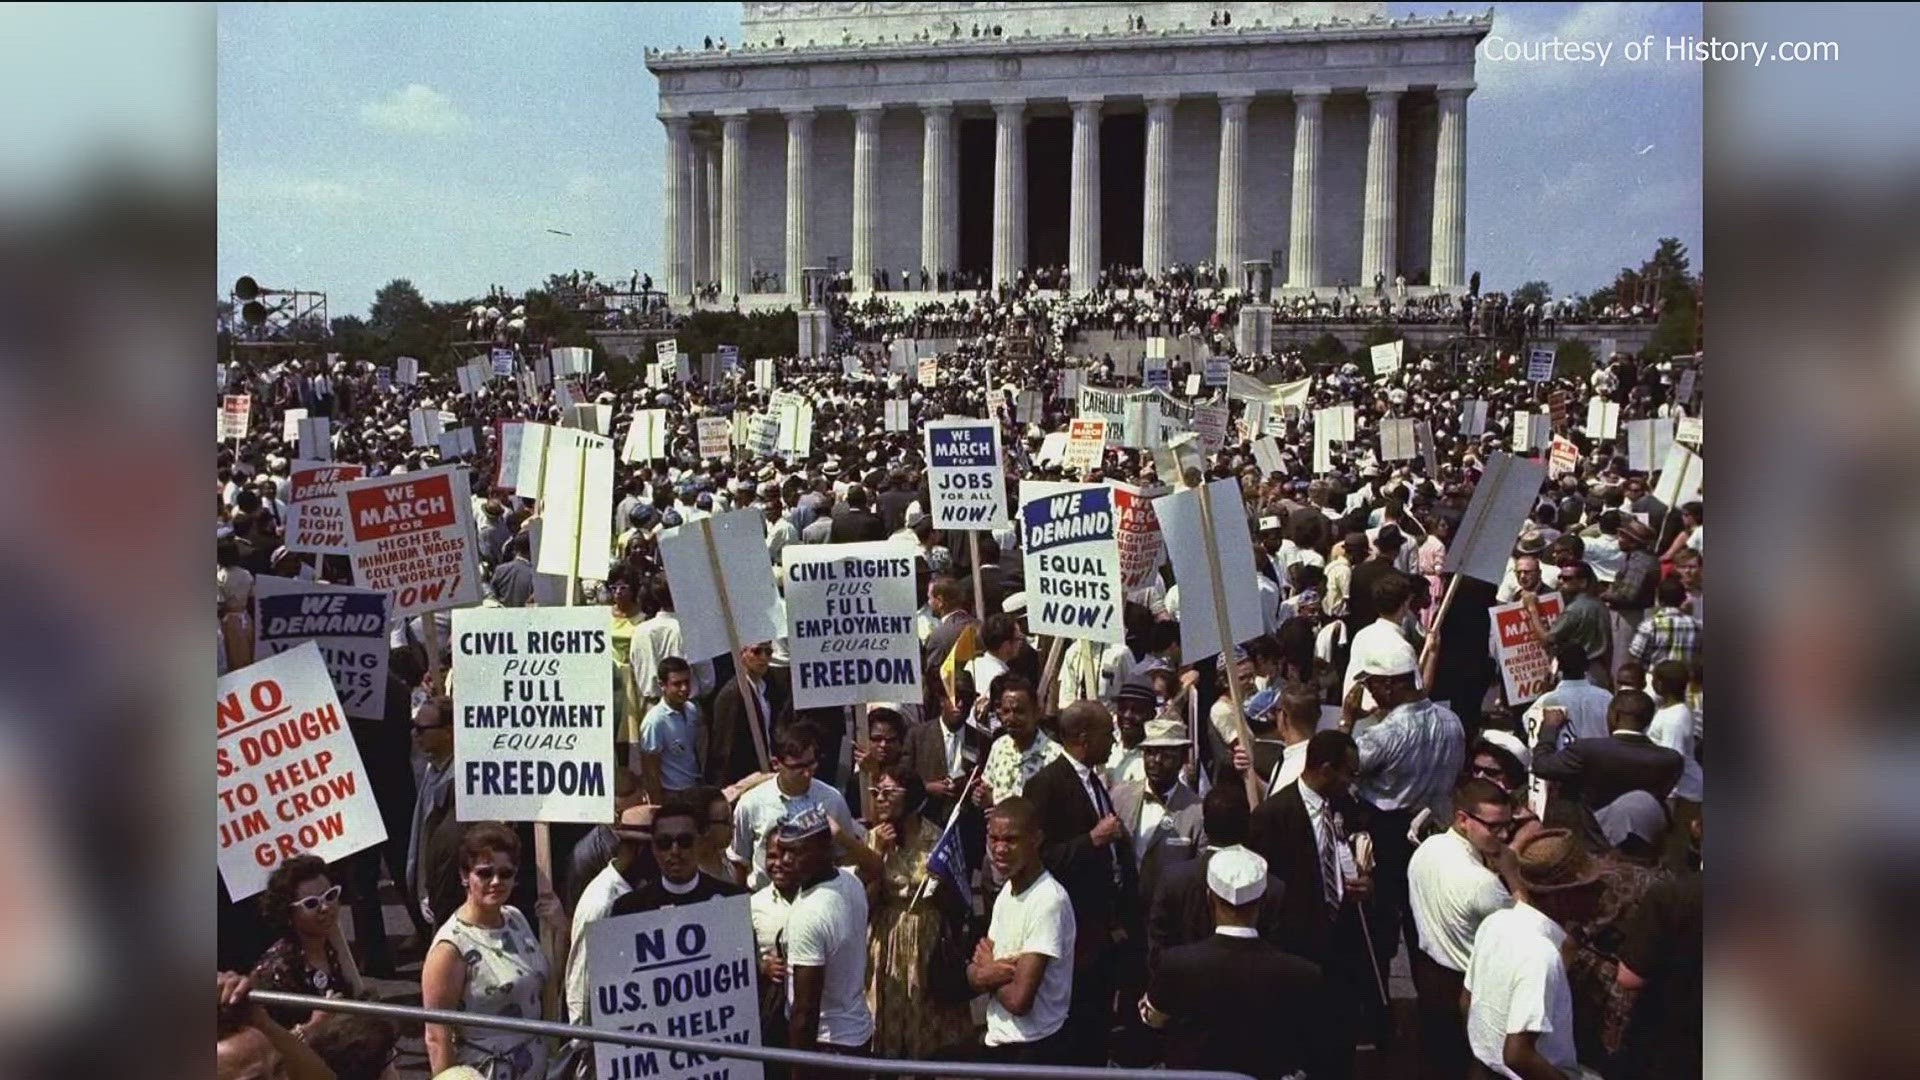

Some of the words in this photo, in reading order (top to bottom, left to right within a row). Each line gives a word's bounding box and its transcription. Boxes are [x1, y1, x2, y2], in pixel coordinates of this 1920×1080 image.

[951, 430, 970, 441] WE
[935, 442, 990, 457] MARCH
[313, 468, 341, 484] WE
[938, 472, 993, 490] JOBS
[295, 482, 339, 500] DEMA
[383, 484, 416, 502] WE
[301, 504, 344, 518] EQUA
[360, 495, 447, 527] MARCH
[942, 503, 998, 522] NOW!
[1049, 492, 1082, 520] WE
[299, 517, 344, 532] RIGHT
[389, 519, 424, 534] FOR
[1030, 511, 1110, 548] DEMAND
[357, 547, 420, 569] MINIMUM
[423, 537, 465, 556] WAGES
[377, 530, 443, 553] HIGHER
[365, 558, 434, 580] COVERAGE
[438, 551, 463, 564] FOR
[371, 579, 395, 590] ALL
[398, 563, 461, 584] WORKERS
[790, 561, 838, 582] CIVIL
[844, 558, 911, 579] RIGHTS
[1040, 554, 1107, 577] EQUAL
[825, 581, 873, 596] PLUS
[1040, 577, 1111, 601] RIGHTS
[301, 595, 348, 615] WE
[826, 597, 878, 617] FULL
[1042, 601, 1114, 630] NOW!
[268, 613, 381, 636] DEMAND
[795, 616, 913, 639] EMPLOYMENT
[460, 631, 519, 656] CIVIL
[527, 630, 607, 655] RIGHTS
[820, 637, 890, 653] EQUALS
[503, 658, 561, 677] PLUS
[799, 658, 916, 690] FREEDOM
[503, 679, 565, 702] FULL
[463, 704, 606, 729] EMPLOYMENT
[239, 702, 341, 767] DOUGH
[492, 733, 578, 751] EQUALS
[218, 782, 259, 814] TO
[264, 750, 333, 797] HELP
[465, 760, 606, 797] FREEDOM
[219, 809, 271, 849] JIM
[275, 770, 357, 823] CROW
[254, 811, 345, 868] GROW
[635, 923, 707, 964] NO
[598, 981, 648, 1015] U.S.
[652, 958, 750, 1007] DOUGH
[667, 1005, 736, 1039] HELP
[607, 1051, 660, 1080] JIM
